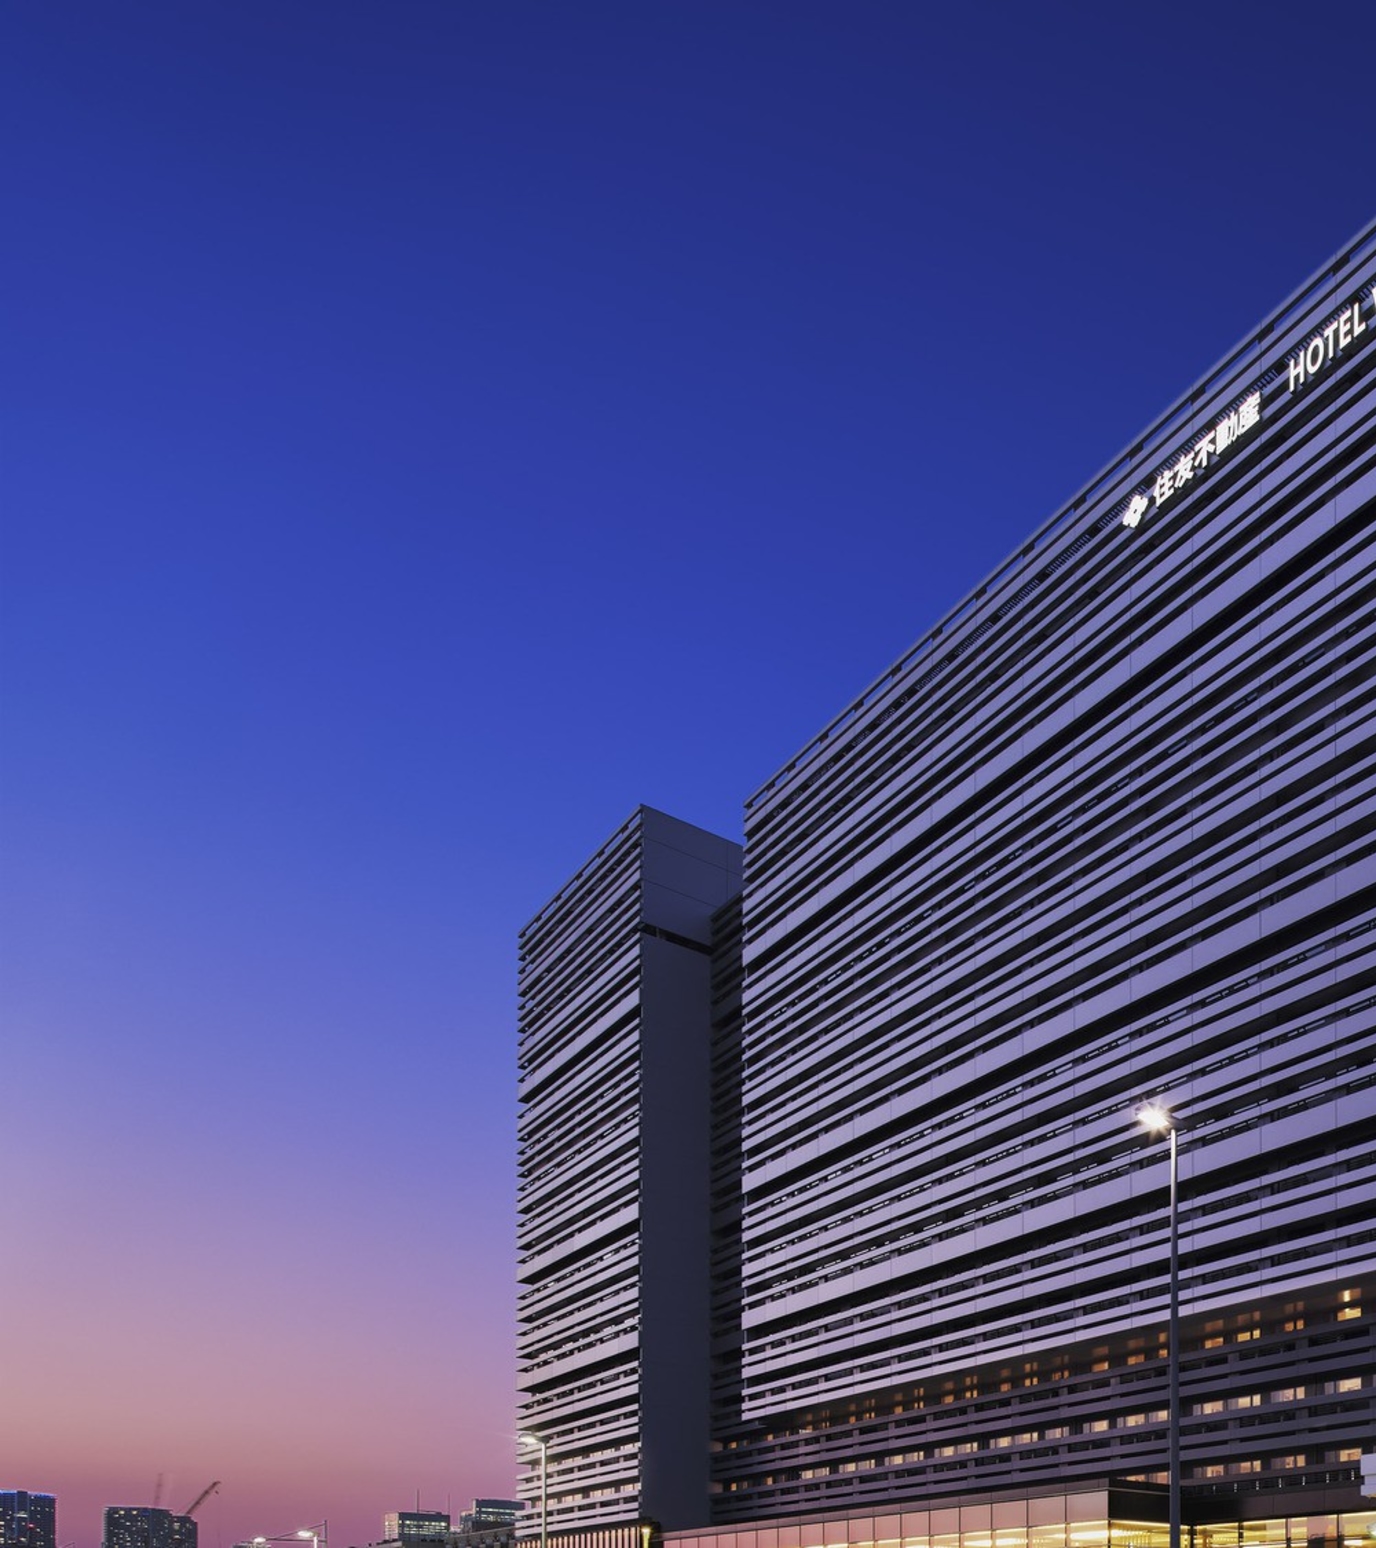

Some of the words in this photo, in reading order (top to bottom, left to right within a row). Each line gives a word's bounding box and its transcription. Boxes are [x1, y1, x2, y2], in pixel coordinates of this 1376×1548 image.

[1289, 303, 1366, 392] HOTEL
[1152, 391, 1261, 507] 住友不動産
